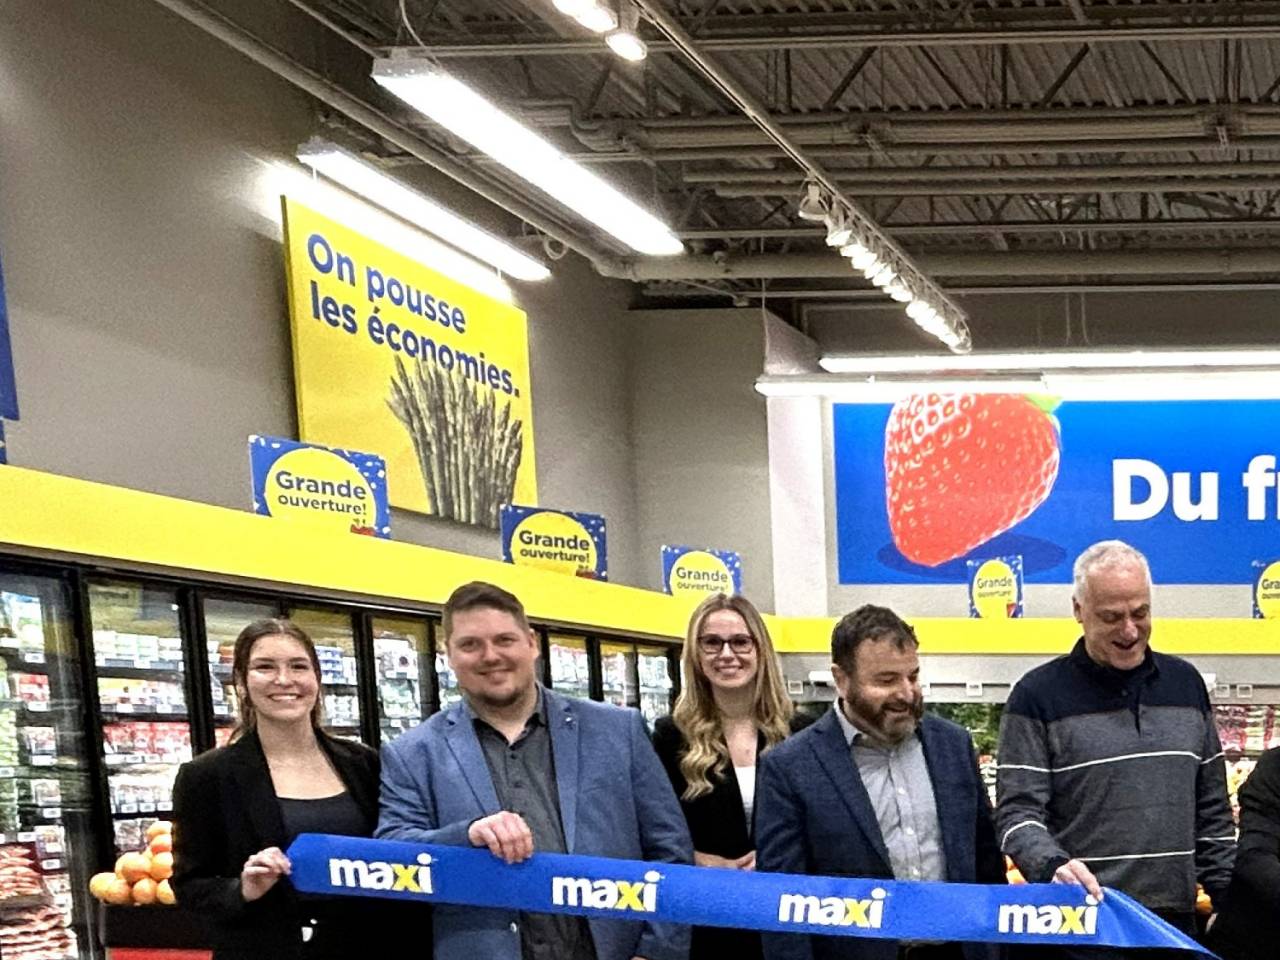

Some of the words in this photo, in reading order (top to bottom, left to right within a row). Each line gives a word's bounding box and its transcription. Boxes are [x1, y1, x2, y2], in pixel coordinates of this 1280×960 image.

[307, 234, 356, 287] On
[366, 265, 467, 335] pousse
[310, 279, 358, 335] les
[367, 306, 520, 398] économies.
[275, 470, 367, 500] Grande
[277, 493, 367, 517] ouverture!
[1112, 458, 1219, 521] Du
[518, 529, 590, 551] Grande
[519, 547, 590, 564] ouverture!
[676, 566, 728, 583] Grande
[977, 576, 1013, 589] Grande
[329, 852, 434, 895] maxi
[551, 870, 661, 913] maxi
[778, 887, 888, 930] maxi
[997, 893, 1099, 936] maxi
